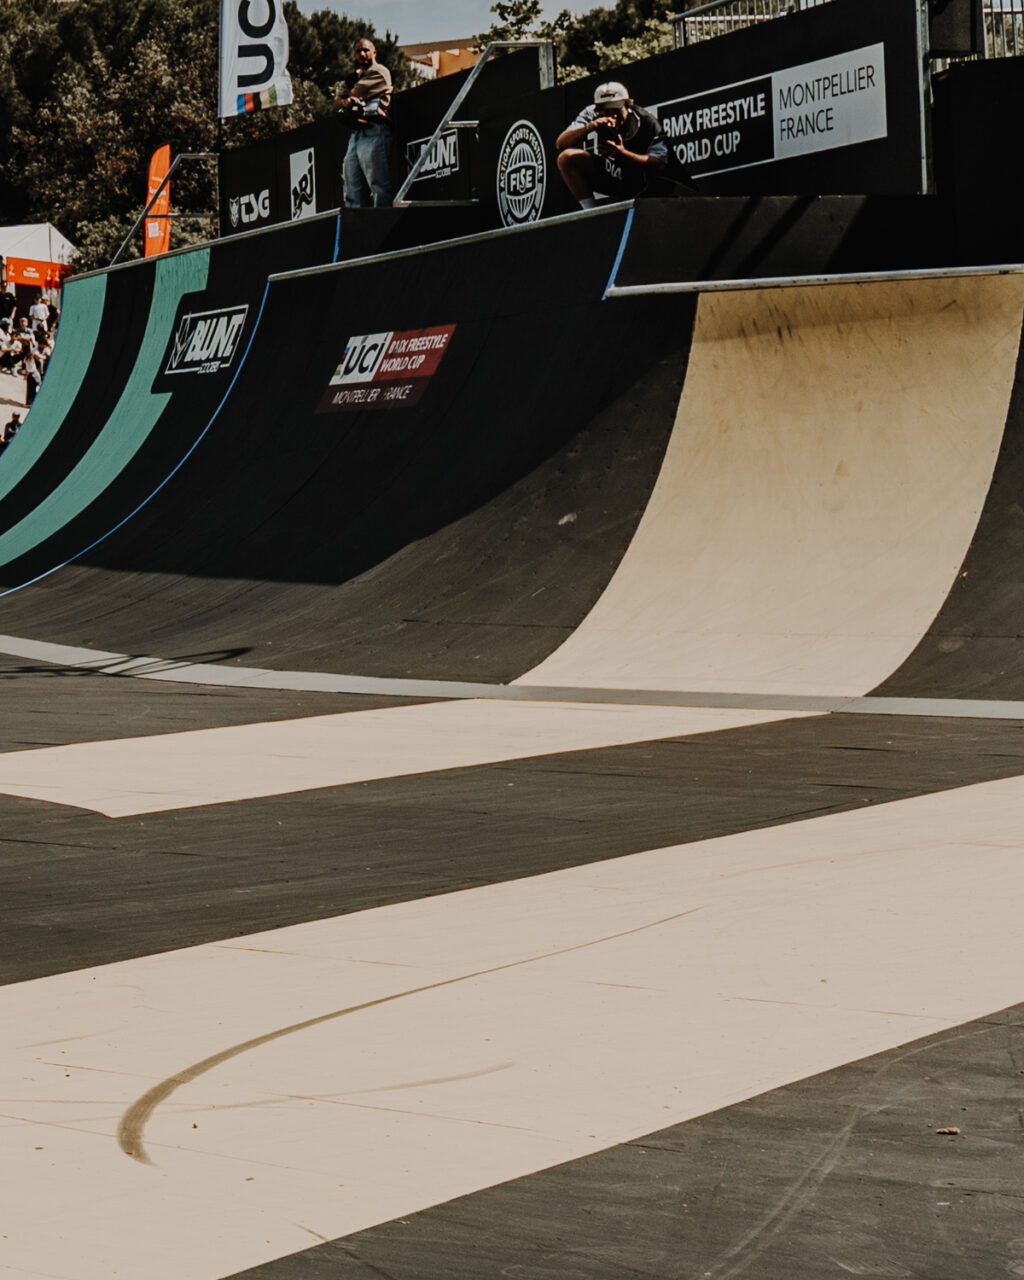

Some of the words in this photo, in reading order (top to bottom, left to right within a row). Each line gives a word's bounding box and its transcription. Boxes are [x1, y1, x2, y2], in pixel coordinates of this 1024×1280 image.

[778, 64, 876, 111] MONTPELLIER
[663, 112, 694, 138] BMX
[696, 93, 766, 132] FREESTYLE
[779, 107, 834, 142] FRANCE
[500, 145, 511, 188] ACTION
[509, 128, 529, 145] SPORTS
[673, 138, 711, 165] ORLD
[714, 130, 741, 157] CUP
[510, 168, 533, 193] FISE
[239, 188, 270, 224] TSG
[183, 313, 246, 363] BLUNT
[342, 335, 387, 377] UCI
[406, 333, 449, 352] FREESTYLE
[380, 356, 410, 373] WORLD
[407, 354, 426, 370] CUP
